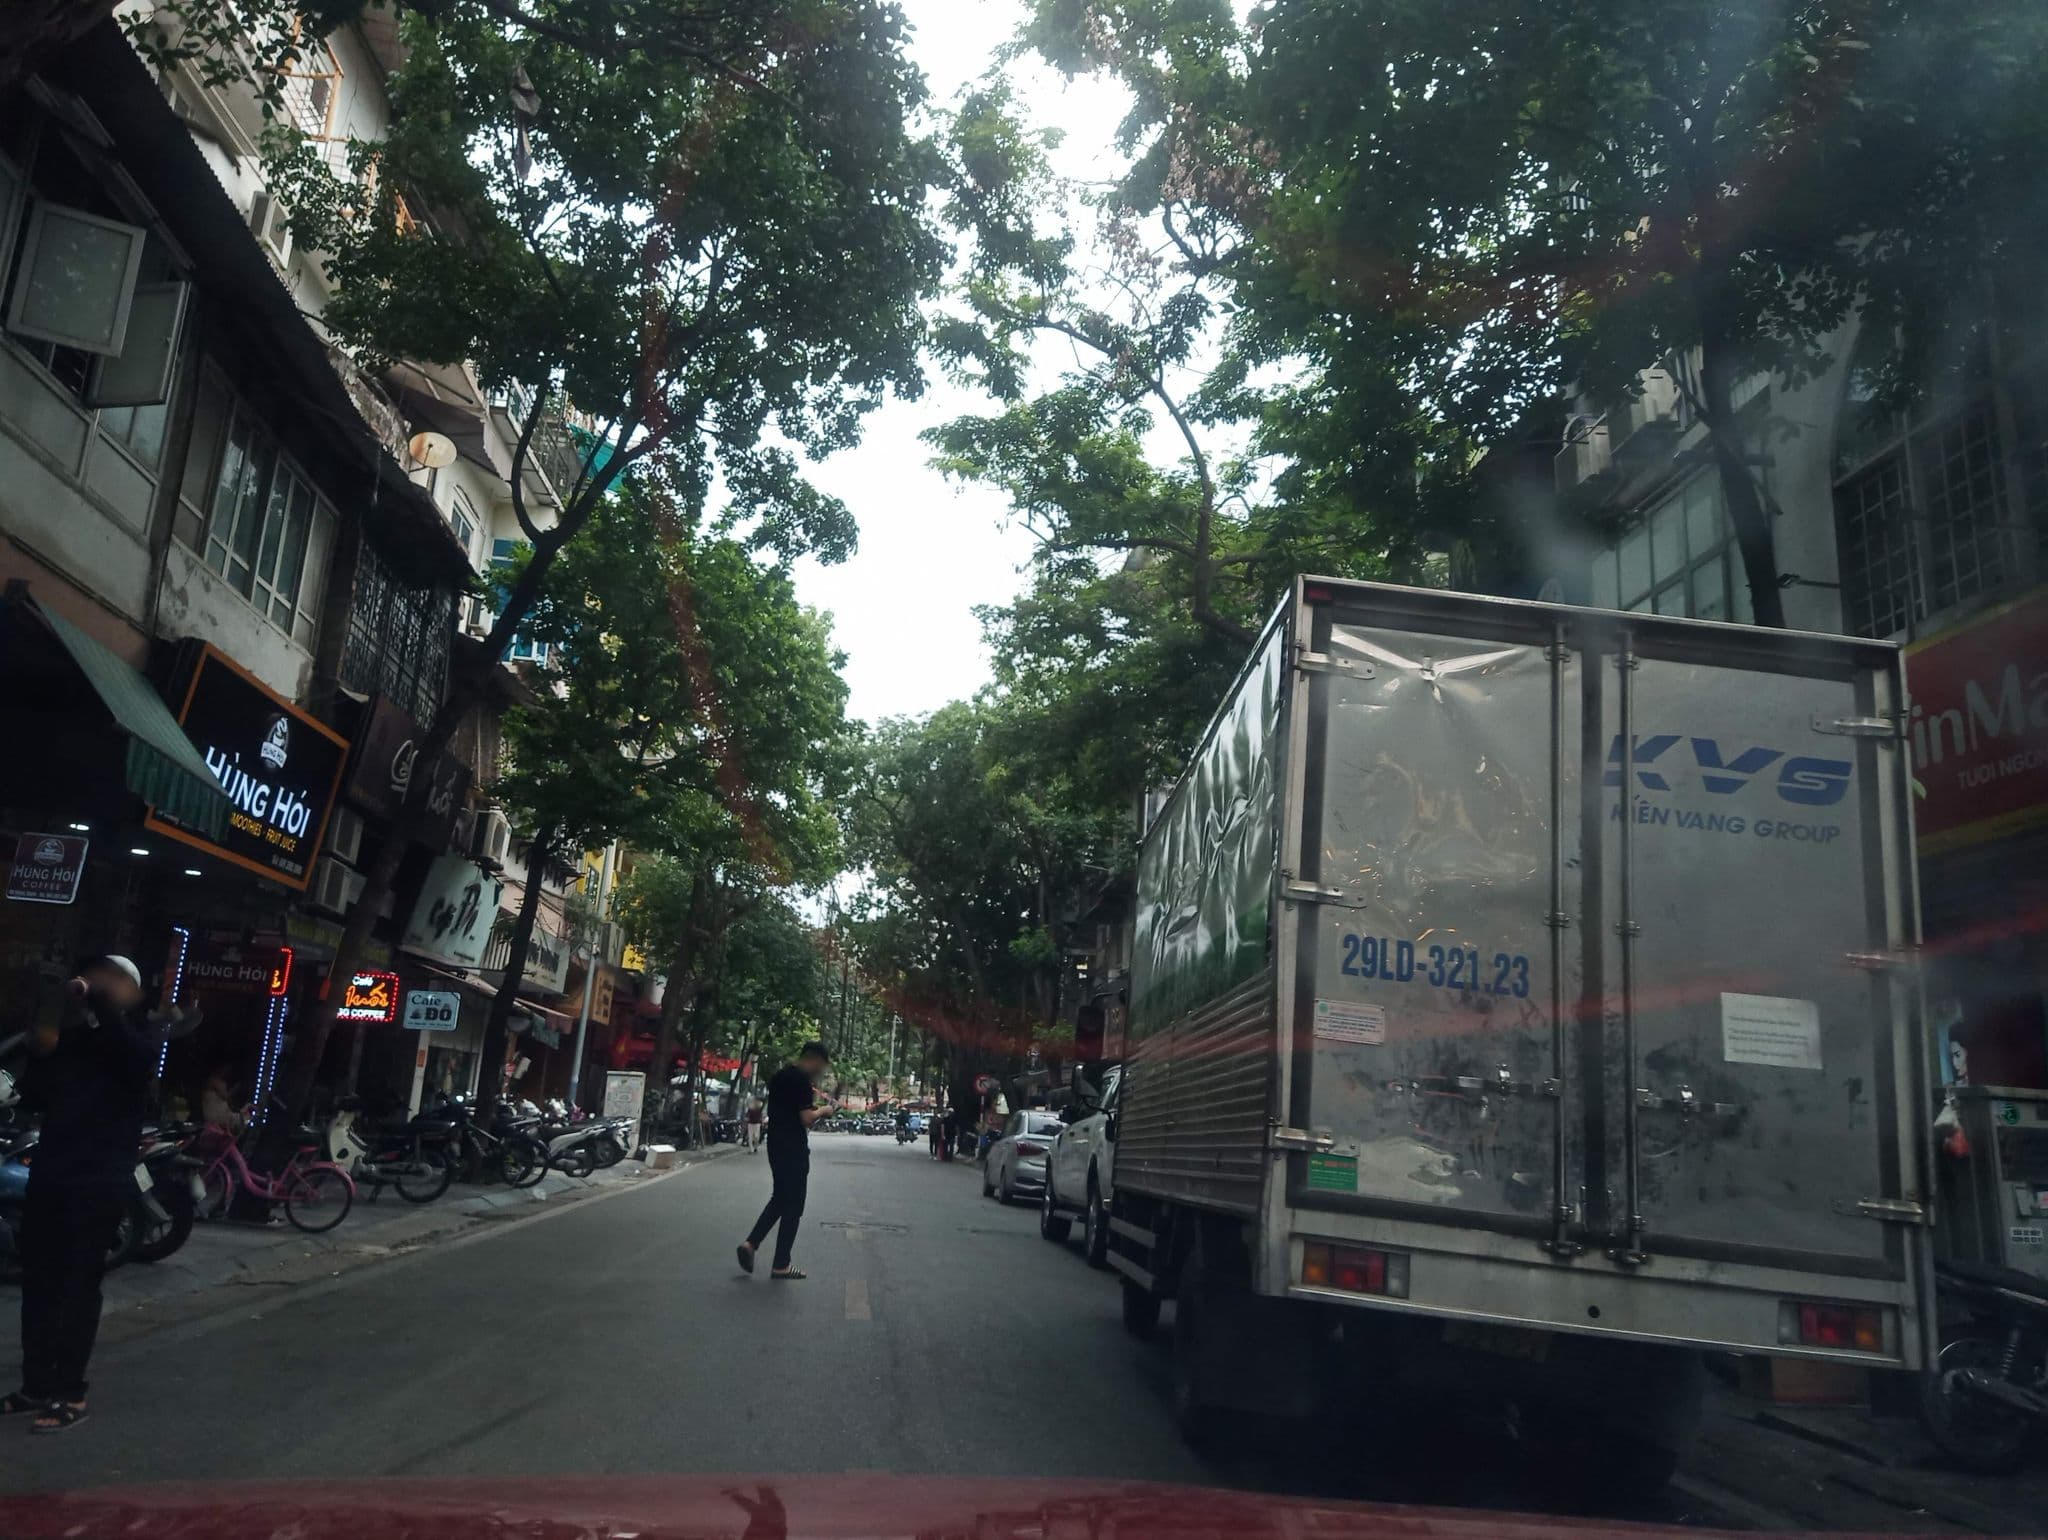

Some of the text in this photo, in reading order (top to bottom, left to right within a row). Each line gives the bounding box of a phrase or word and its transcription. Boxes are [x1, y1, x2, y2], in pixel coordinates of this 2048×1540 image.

[1602, 734, 1853, 806] KVS
[269, 786, 312, 838] HÓI
[1753, 819, 1841, 843] GROUP
[1341, 933, 1530, 999] 29LD-321.23
